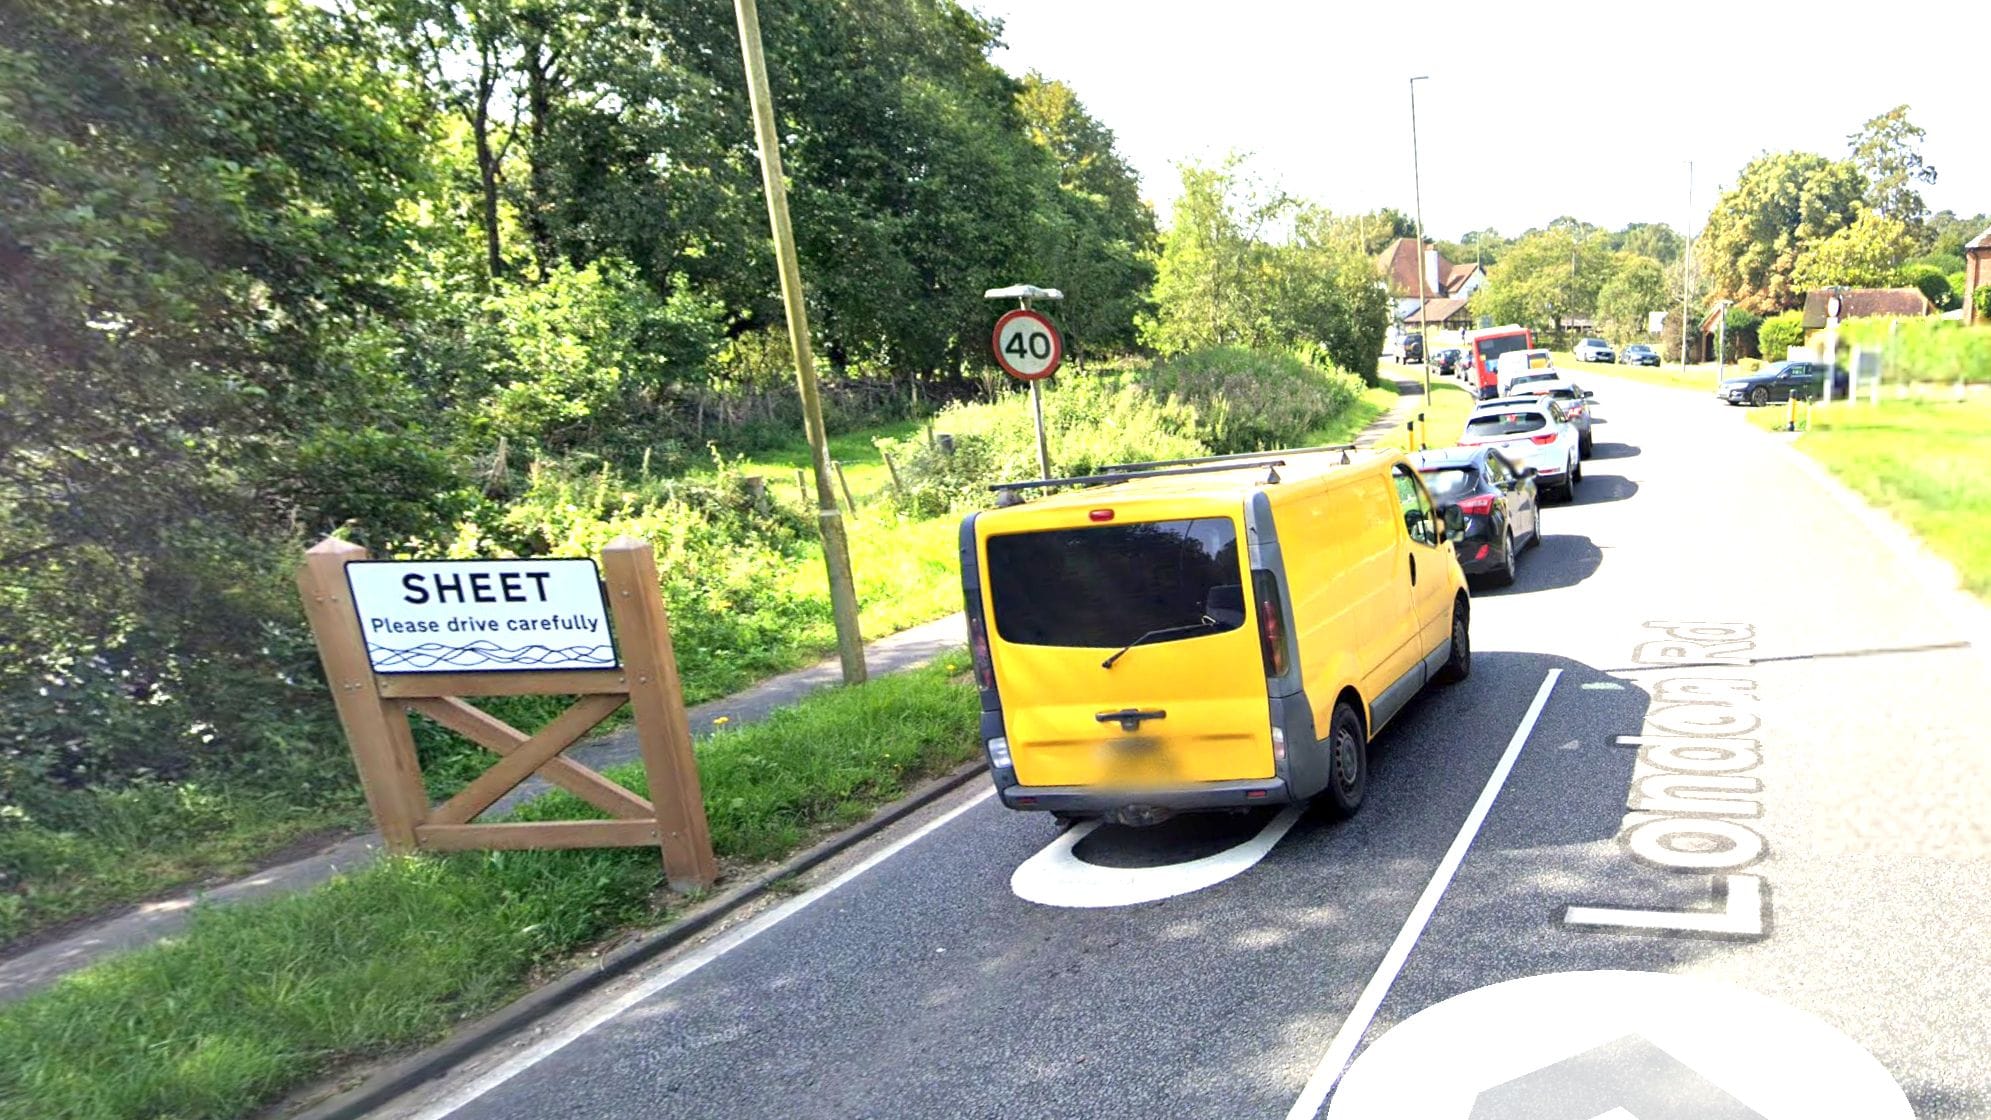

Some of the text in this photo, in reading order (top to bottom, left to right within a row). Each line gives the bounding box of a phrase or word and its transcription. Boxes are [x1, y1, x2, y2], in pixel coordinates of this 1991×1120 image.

[1005, 331, 1051, 360] 40
[402, 571, 551, 605] SHEET
[371, 614, 598, 634] Please drive carefully
